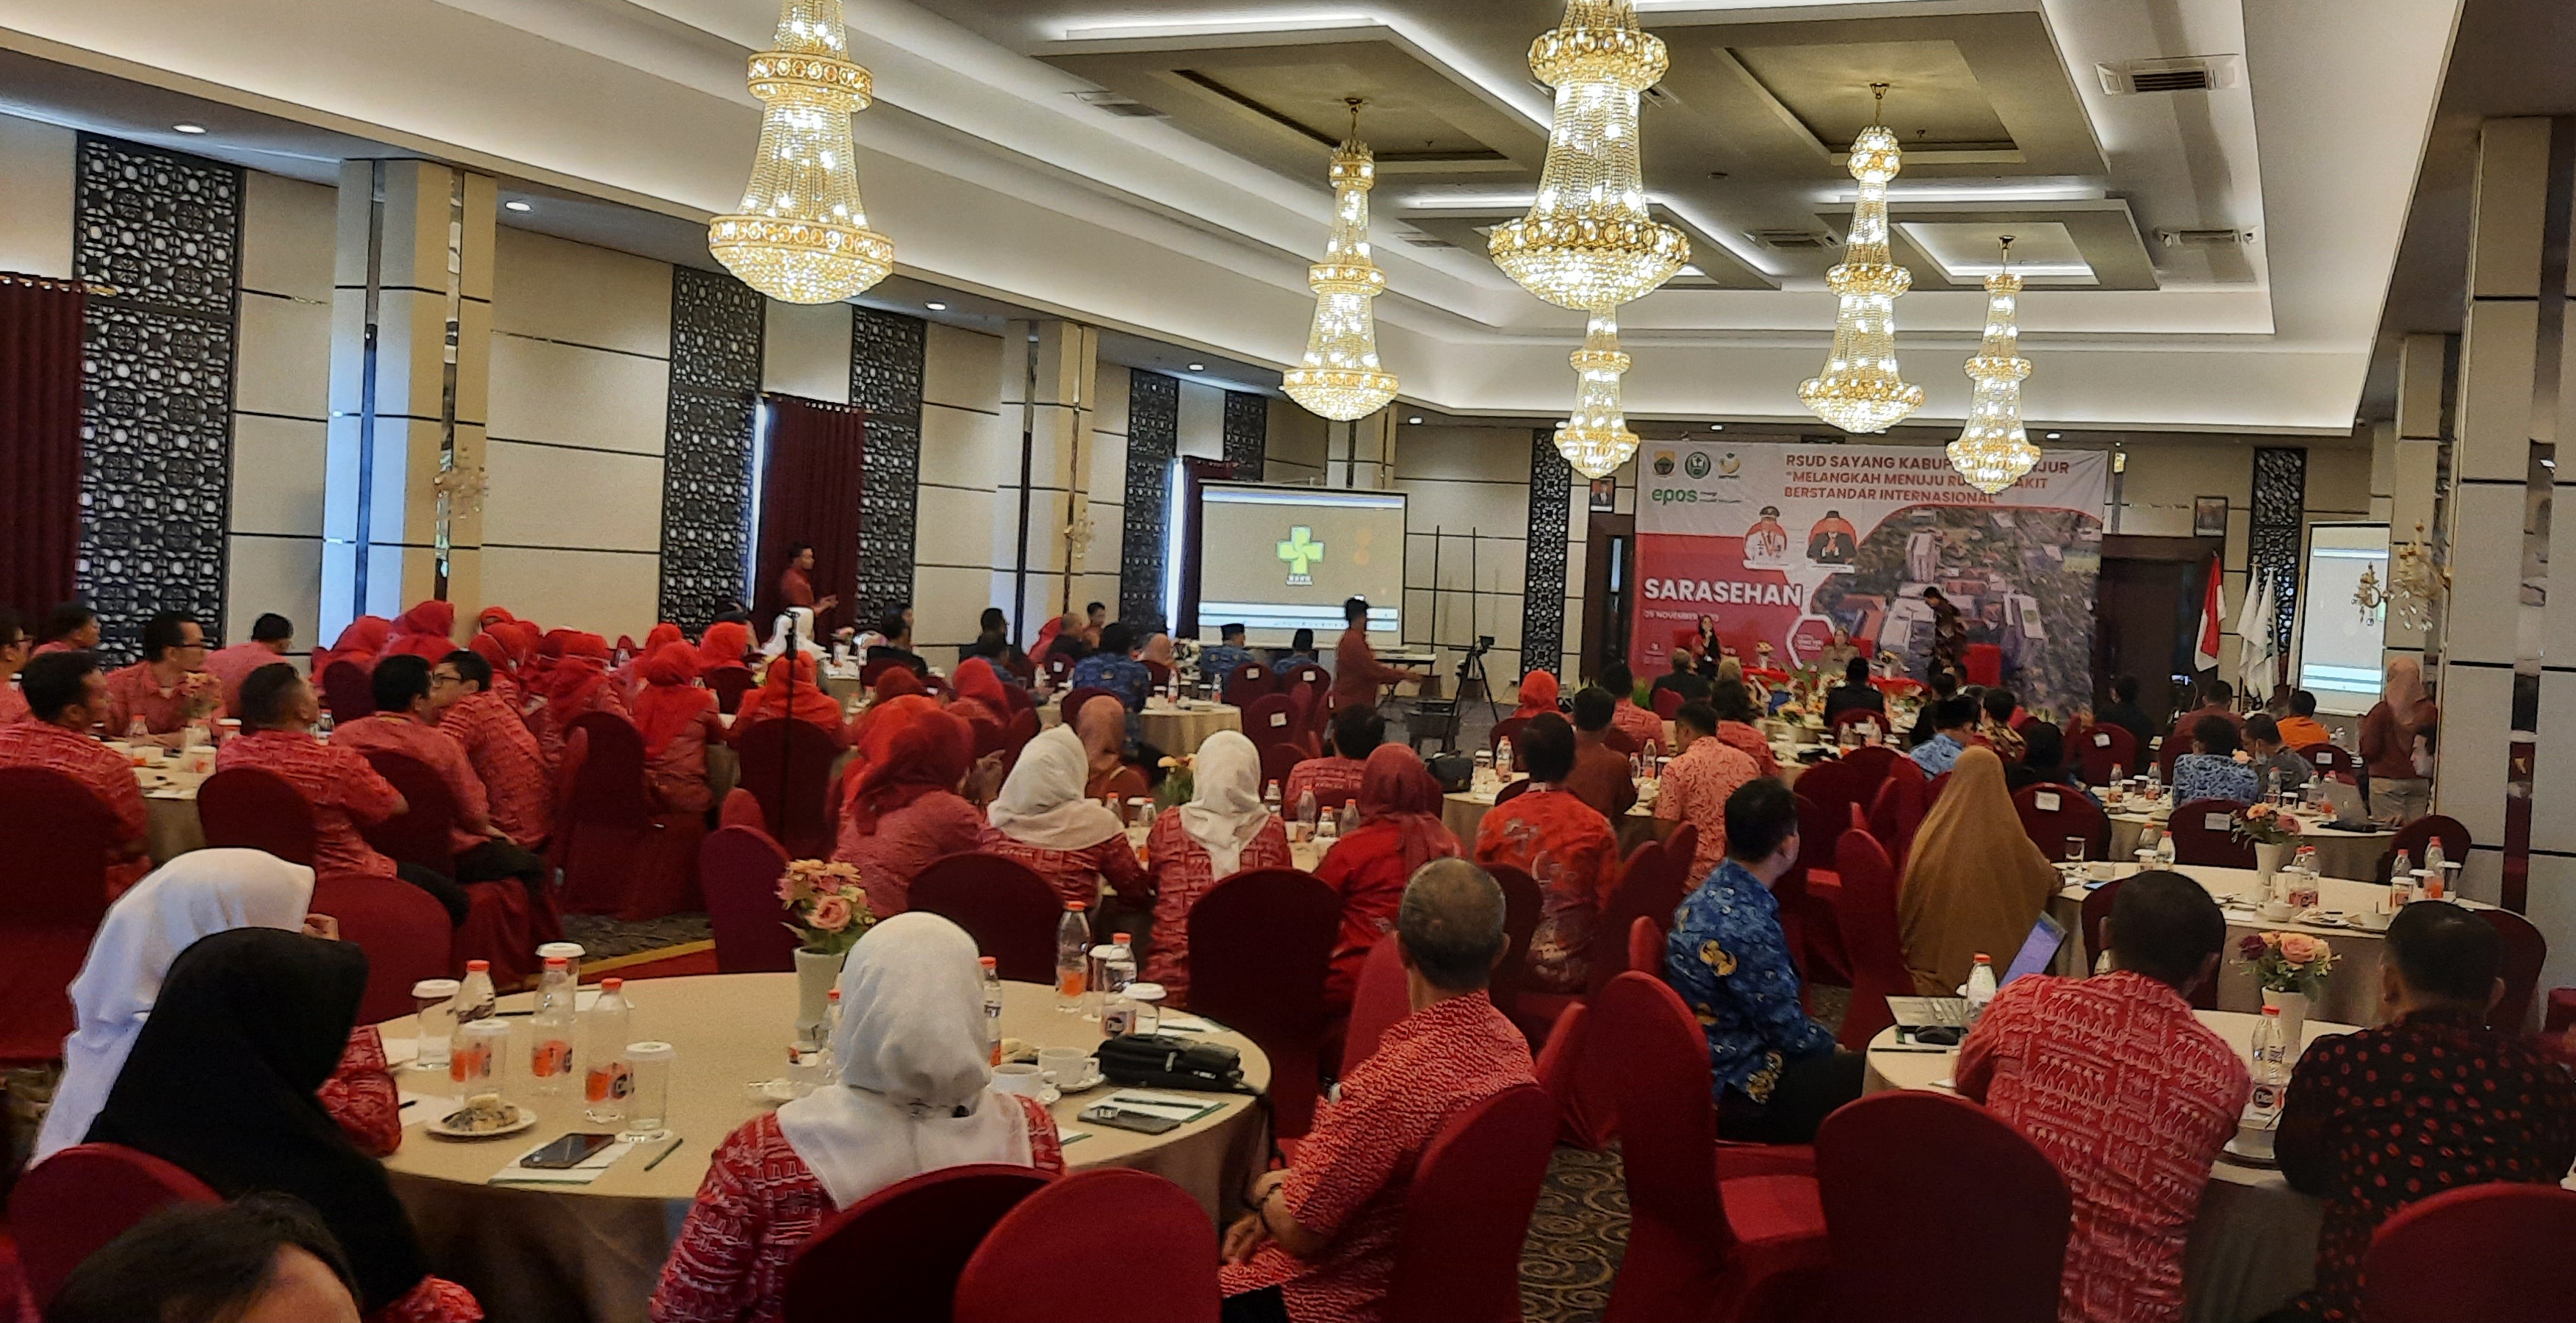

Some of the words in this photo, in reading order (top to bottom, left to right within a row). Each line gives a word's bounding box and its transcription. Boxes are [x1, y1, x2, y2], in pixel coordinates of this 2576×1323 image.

[1786, 454, 1827, 467] RSUD
[1830, 455, 1895, 469] SAYANG
[1899, 457, 1951, 470] KABUP
[1884, 474, 1944, 487] MENUJU
[2013, 477, 2048, 490] AKIT
[1652, 488, 1698, 506] epos
[1785, 487, 1877, 500] BERSTANDAR
[1644, 578, 1802, 607] SARASEHAN
